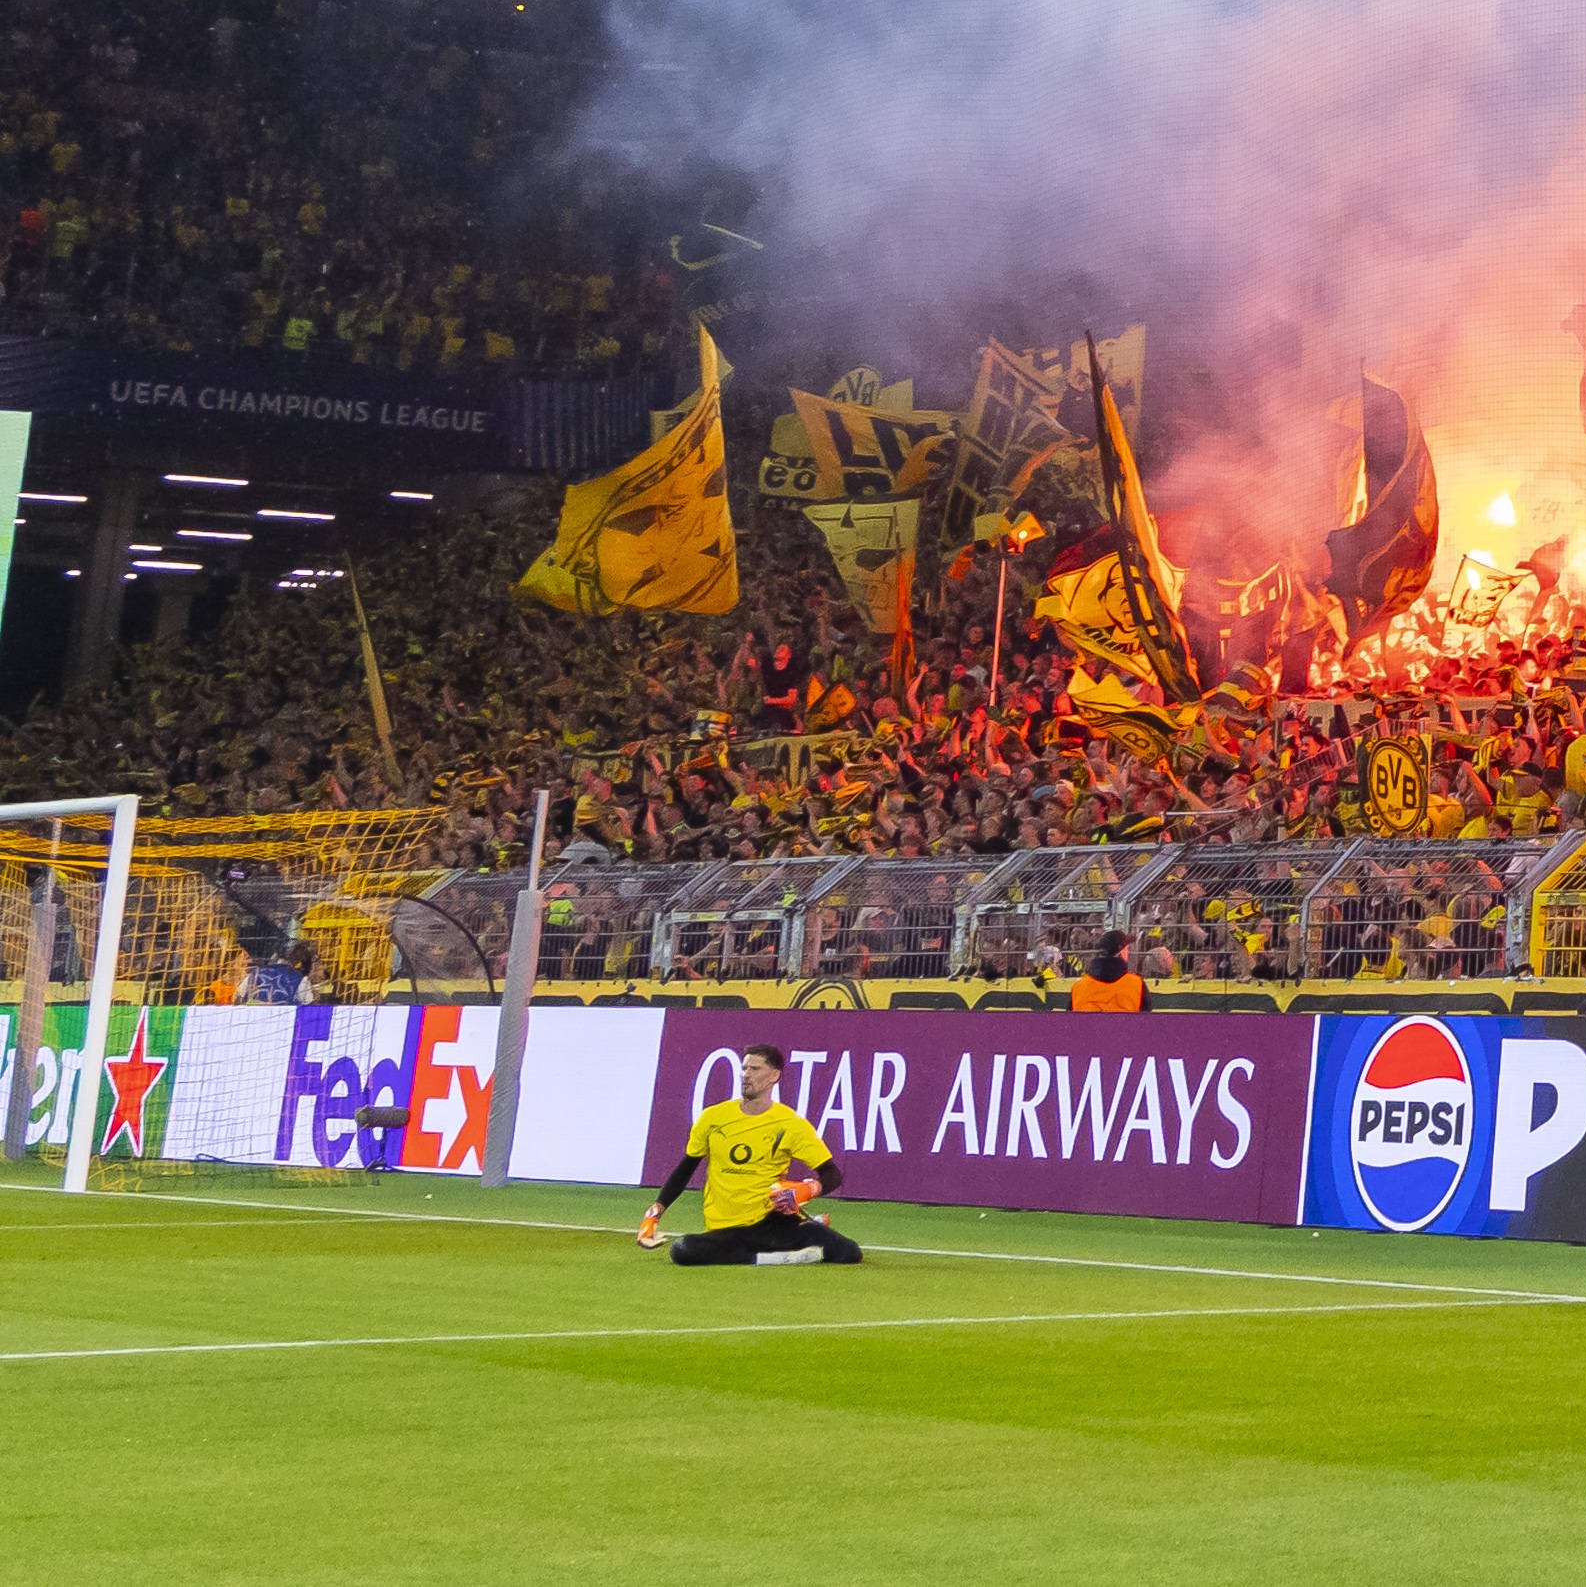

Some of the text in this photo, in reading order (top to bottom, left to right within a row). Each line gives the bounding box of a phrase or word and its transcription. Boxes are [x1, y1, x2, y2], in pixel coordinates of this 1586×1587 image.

[110, 379, 487, 433] UEFA CHAMPIONS LEAGUE
[1376, 753, 1417, 809] BVB
[273, 1004, 496, 1171] FedEx
[691, 1046, 1255, 1170] QTAR AIRWAYS
[1357, 1099, 1464, 1147] PEPSI
